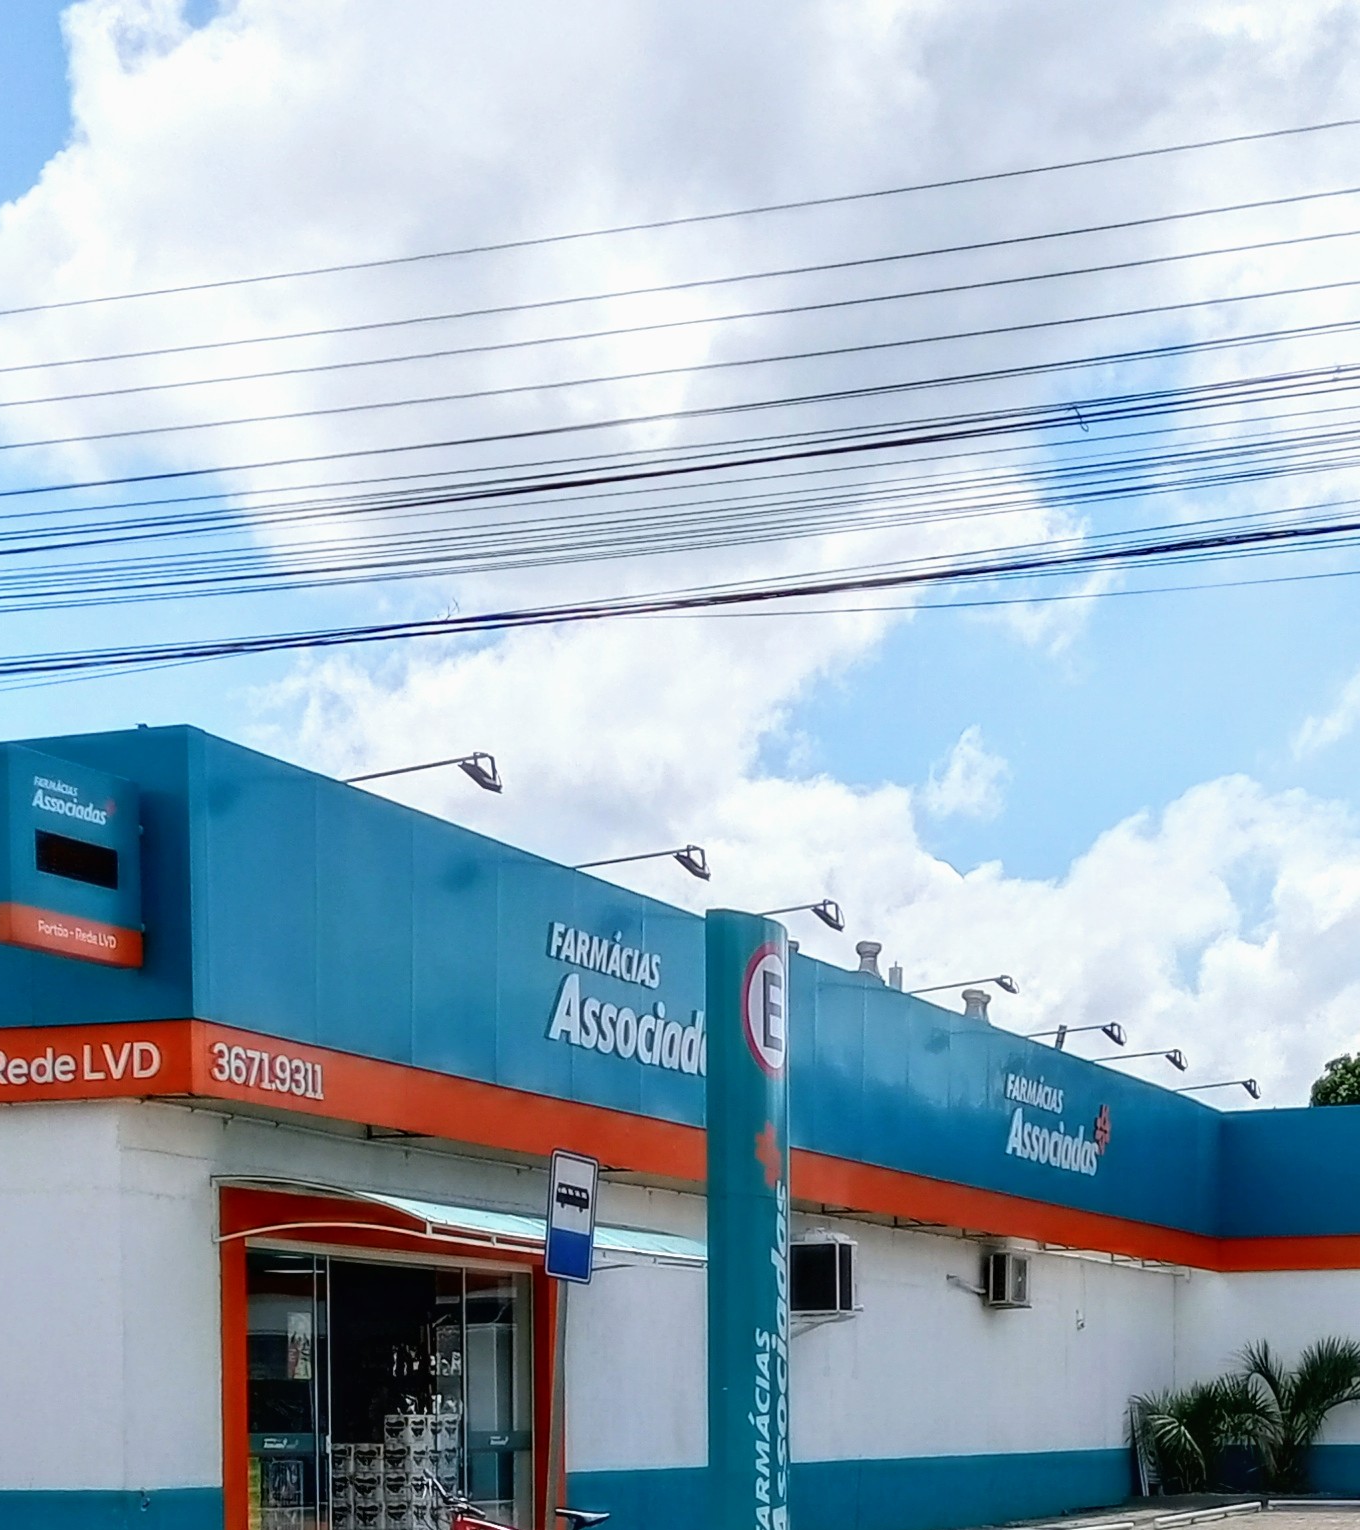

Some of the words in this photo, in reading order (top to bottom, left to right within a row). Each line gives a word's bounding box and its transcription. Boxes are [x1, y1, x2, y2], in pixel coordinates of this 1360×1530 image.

[32, 789, 107, 825] Associadas
[98, 935, 117, 949] LVD
[549, 921, 662, 989] FARMÁCIAS
[548, 973, 707, 1077] Associad
[762, 969, 783, 1053] E
[83, 1041, 162, 1082] LVD
[211, 1042, 324, 1100] 3671.9311
[1006, 1073, 1064, 1114] FARMÁCIAS
[1005, 1107, 1099, 1176] Associadas
